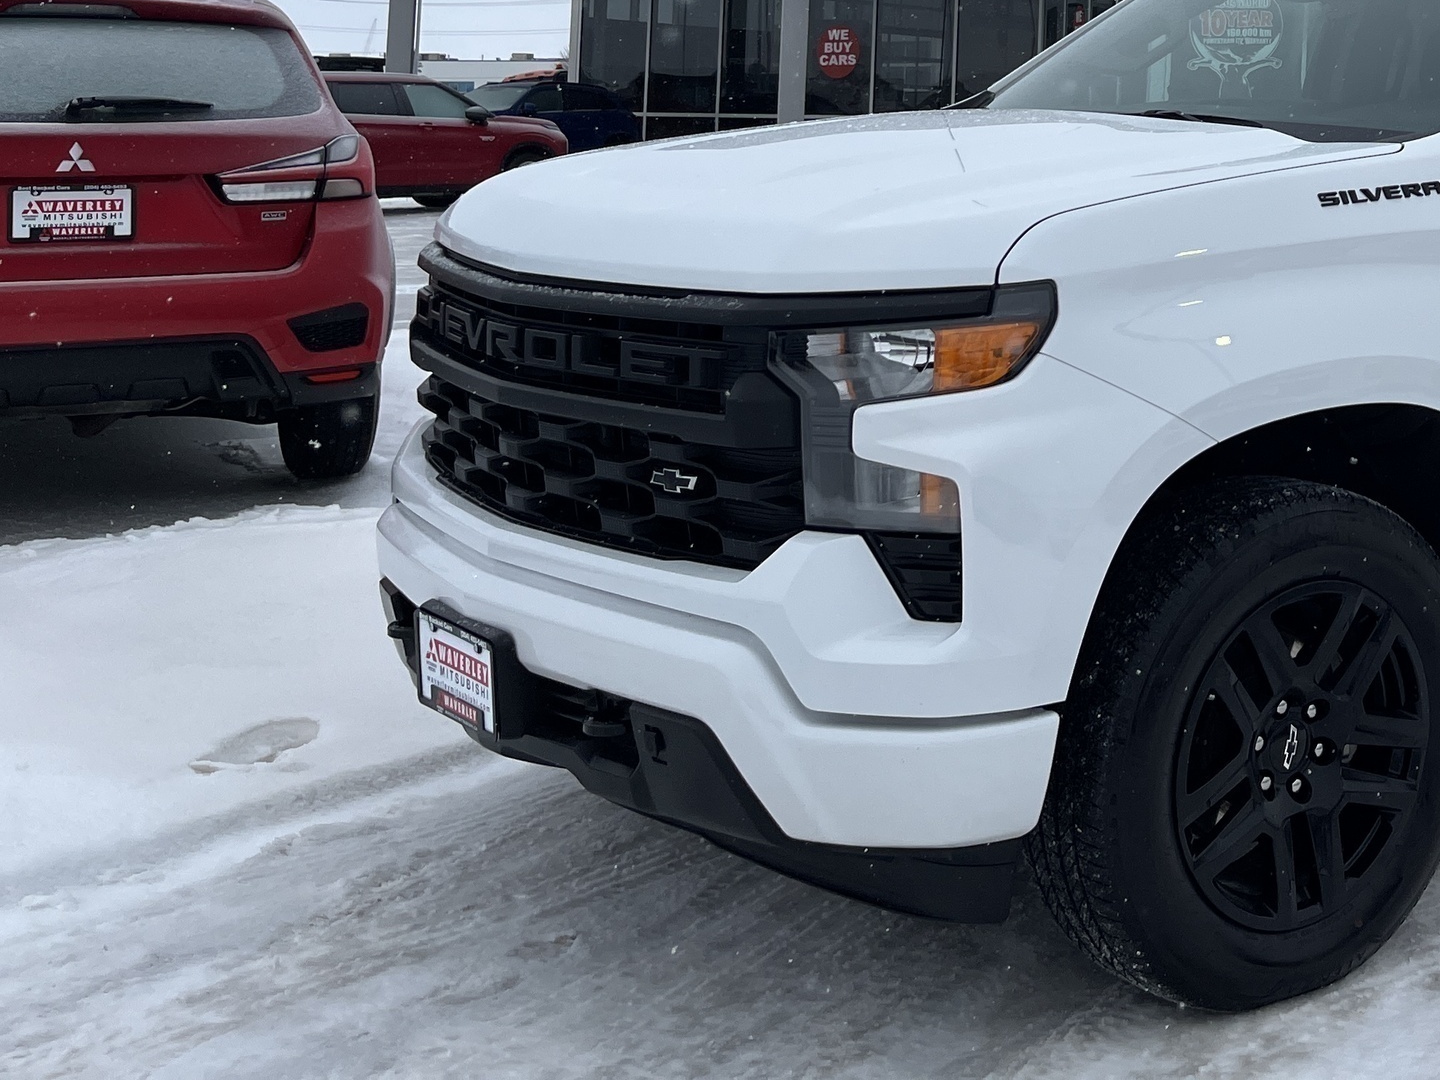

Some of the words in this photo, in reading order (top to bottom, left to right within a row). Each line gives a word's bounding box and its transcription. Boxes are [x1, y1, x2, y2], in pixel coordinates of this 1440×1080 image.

[1225, 9, 1274, 28] YEAR
[828, 29, 849, 41] WE
[824, 41, 853, 53] BUY
[819, 54, 857, 66] CARS
[42, 200, 122, 212] WAVERLEY
[43, 212, 123, 221] MITSUBISHI
[52, 227, 106, 236] WAVERLEY
[416, 286, 726, 387] CHEVROLET
[438, 643, 488, 684] WAVERLEY
[440, 665, 489, 700] MITSUBISHI
[444, 694, 477, 722] WAVERLEY
